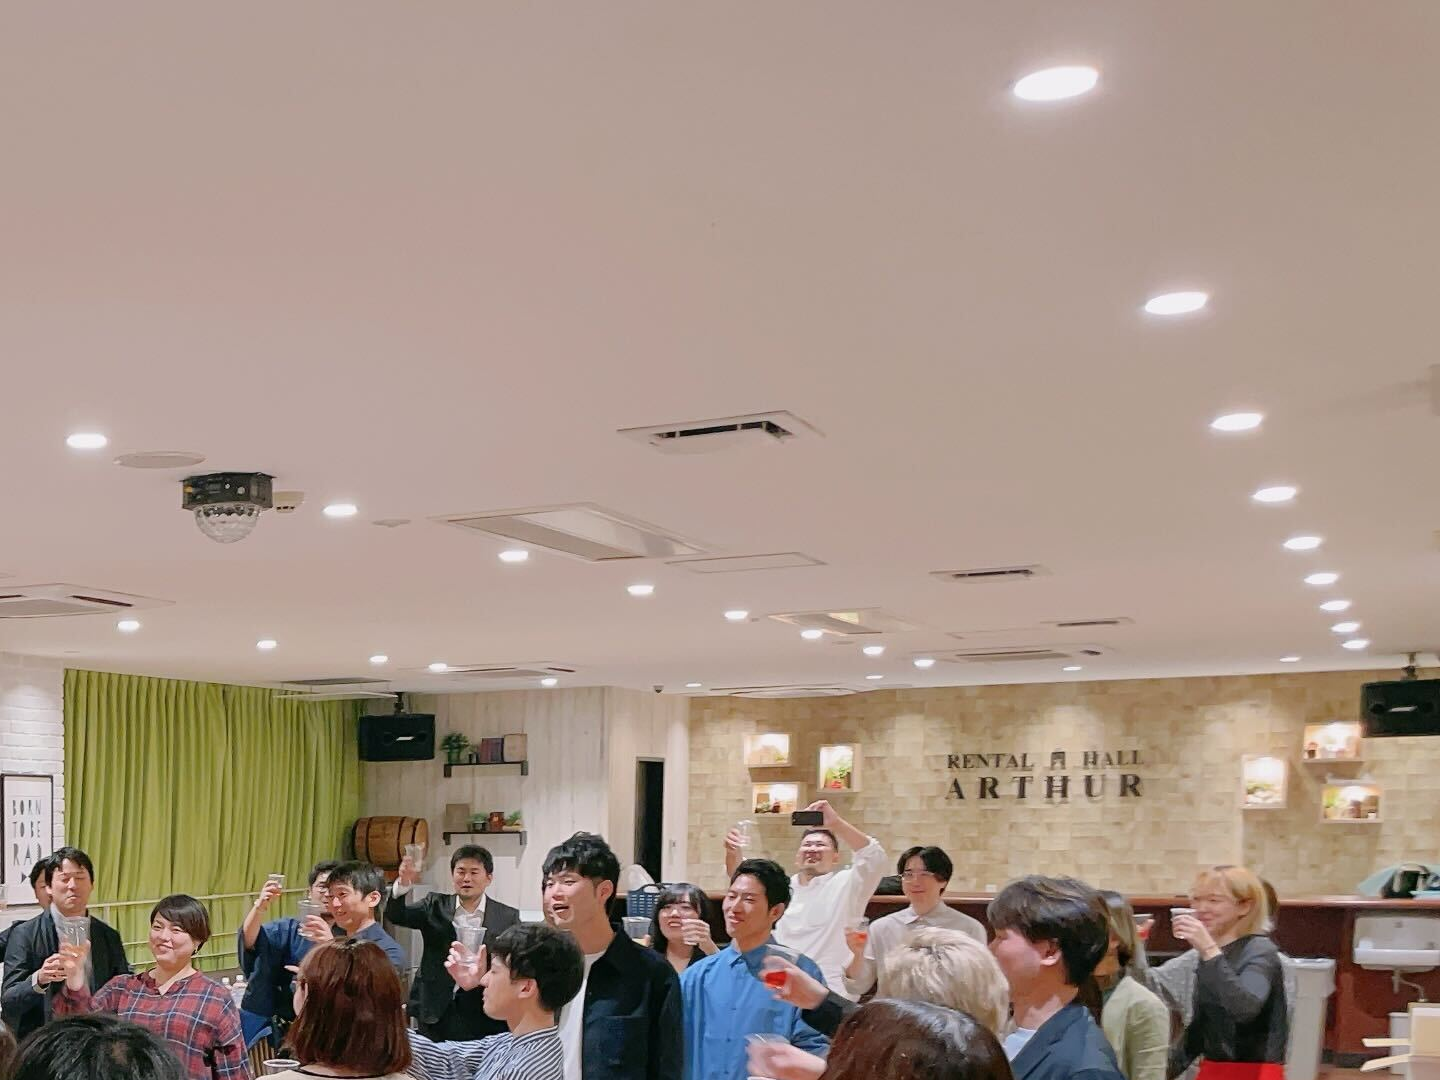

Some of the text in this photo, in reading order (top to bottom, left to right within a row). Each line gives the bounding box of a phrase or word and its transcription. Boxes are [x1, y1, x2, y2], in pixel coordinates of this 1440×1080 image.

[946, 750, 1145, 770] RENTAL HALL
[944, 774, 1144, 800] ARTHUR
[12, 799, 42, 816] BORN
[12, 821, 41, 838] TO BE
